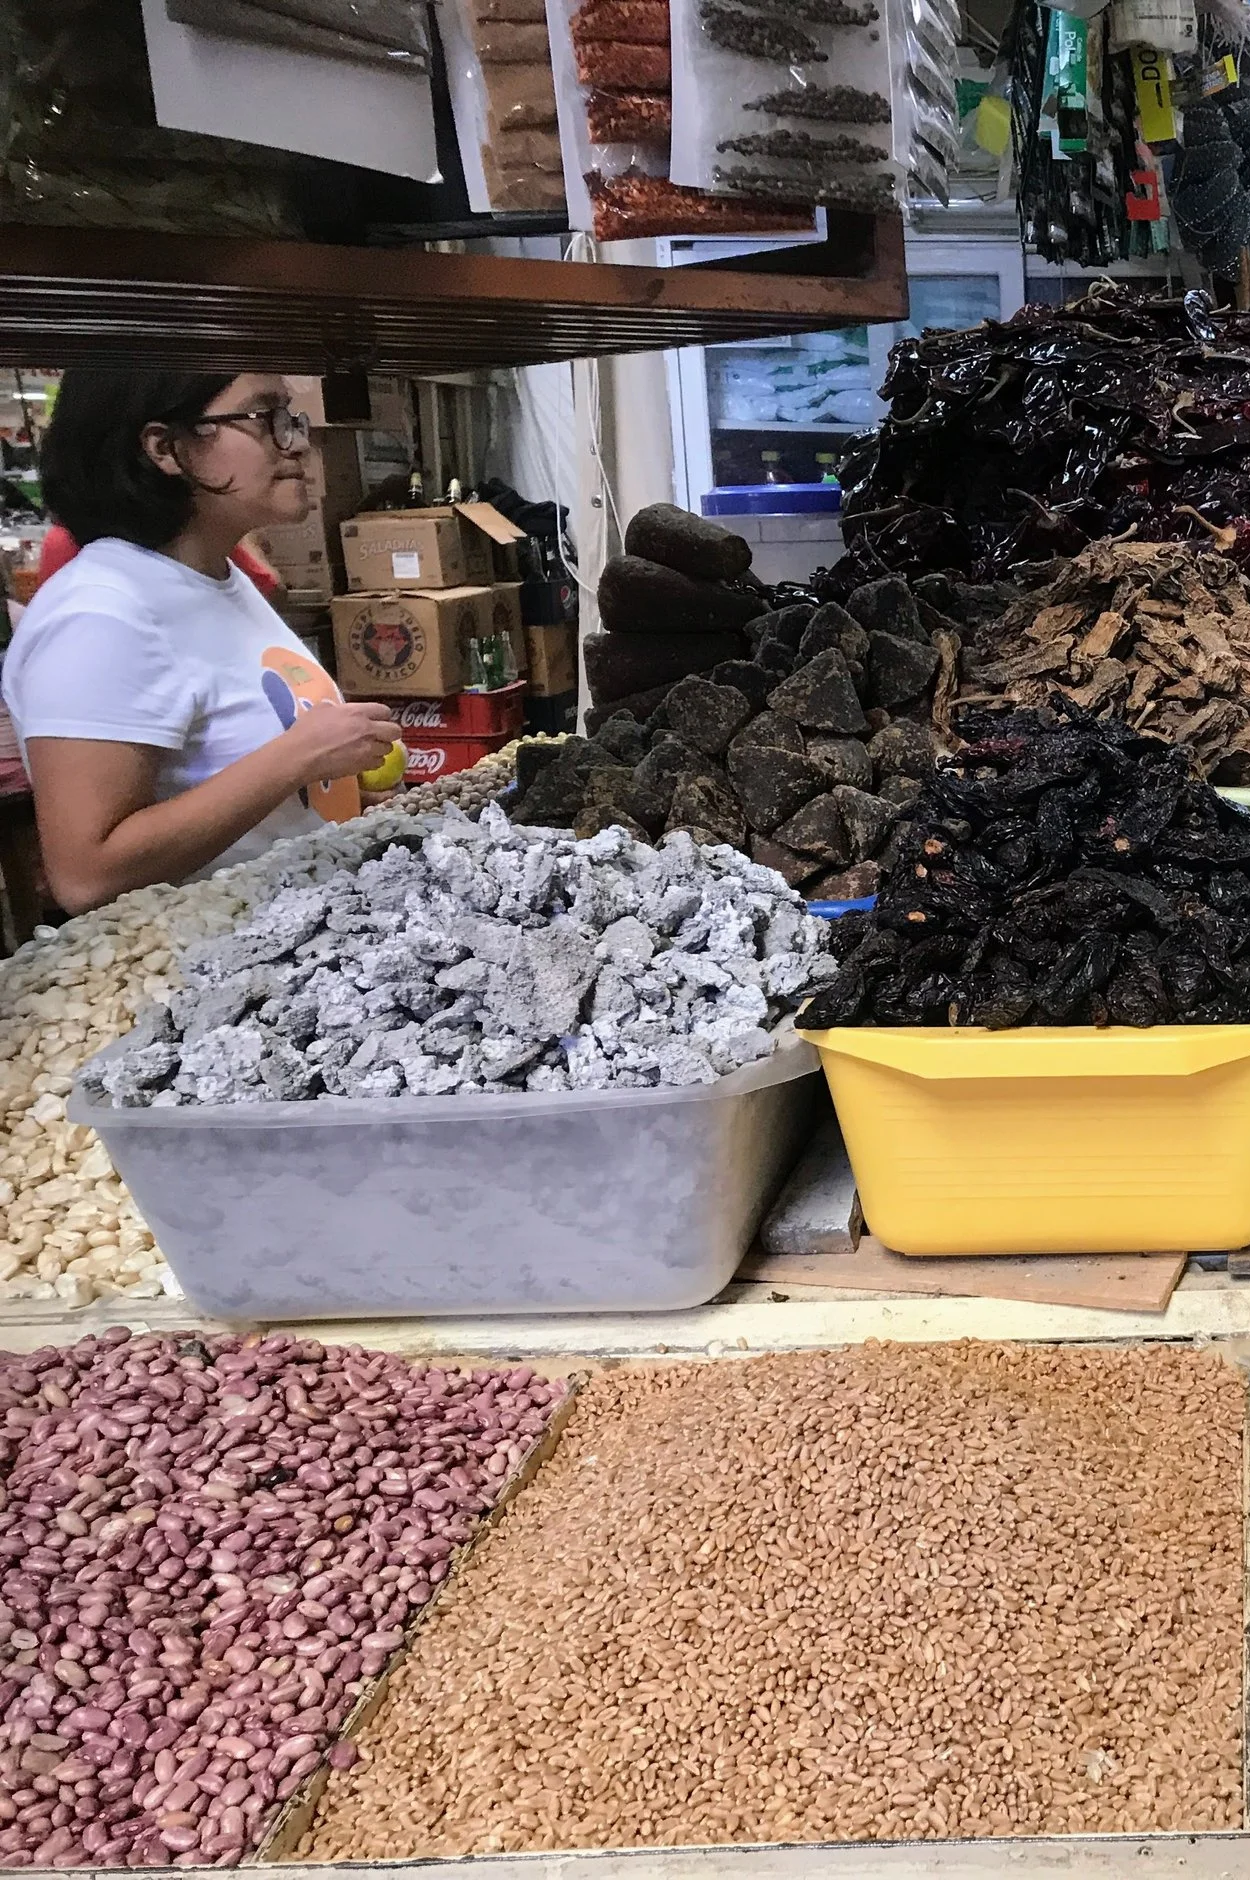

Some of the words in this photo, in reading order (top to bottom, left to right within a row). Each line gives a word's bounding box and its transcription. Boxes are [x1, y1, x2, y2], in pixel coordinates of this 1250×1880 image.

[1065, 32, 1077, 51] Pol
[1138, 46, 1160, 81] DO
[407, 748, 445, 774] Coca
